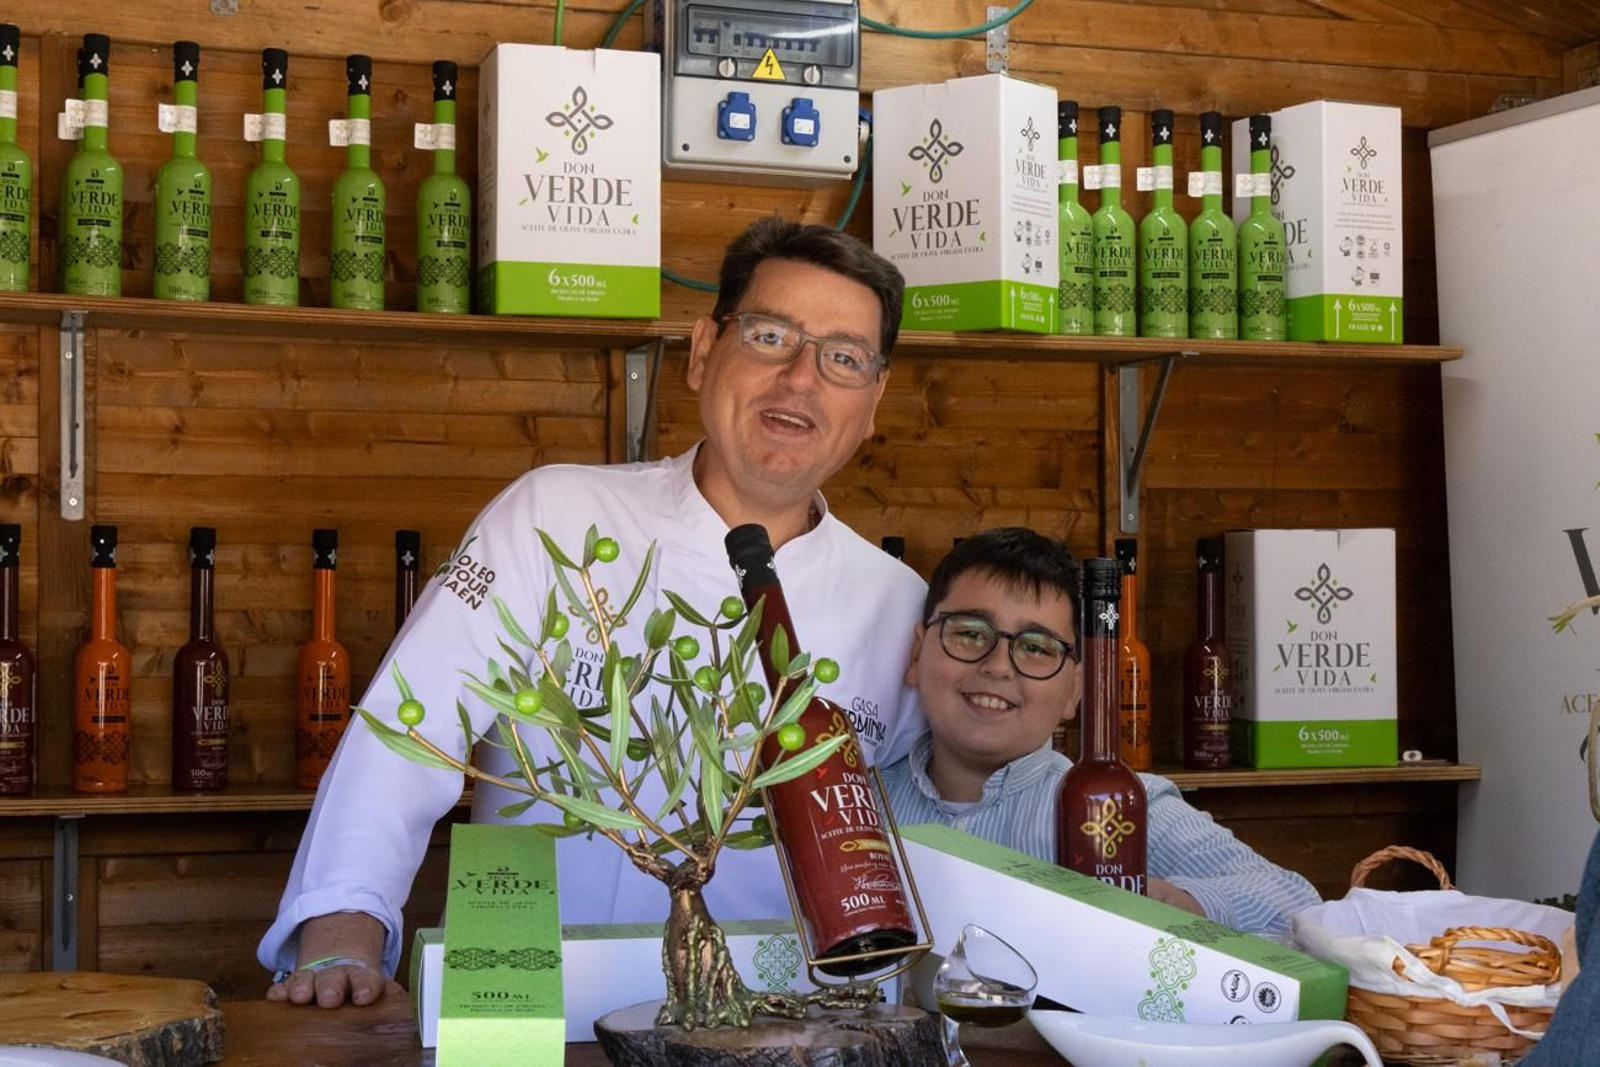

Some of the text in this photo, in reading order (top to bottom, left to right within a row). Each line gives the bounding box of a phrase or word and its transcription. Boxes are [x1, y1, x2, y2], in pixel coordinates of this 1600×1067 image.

[563, 161, 595, 175] DON
[1015, 158, 1047, 179] VERDE
[1021, 176, 1041, 188] VIDA
[1343, 177, 1386, 194] VERDE
[0, 187, 30, 201] RDE
[524, 174, 633, 207] VERDE
[922, 188, 948, 203] DON
[1351, 193, 1377, 203] VIDA
[71, 192, 118, 208] VERDE
[172, 200, 210, 215] VERD
[80, 205, 110, 215] VIDA
[347, 208, 385, 223] VERD
[547, 205, 610, 226] VIDA
[892, 199, 981, 232] VERDE
[910, 230, 962, 249] VIDA
[458, 555, 496, 584] OLEO
[449, 565, 488, 599] TOUR
[1310, 631, 1338, 642] DON
[575, 647, 604, 663] DON
[1277, 643, 1371, 668] VERDE
[1296, 670, 1352, 686] VIDA
[842, 772, 866, 785] DON
[838, 809, 878, 826] VID
[821, 829, 844, 840] ACEITE
[1095, 864, 1123, 876] DON
[456, 879, 550, 889] VERDE
